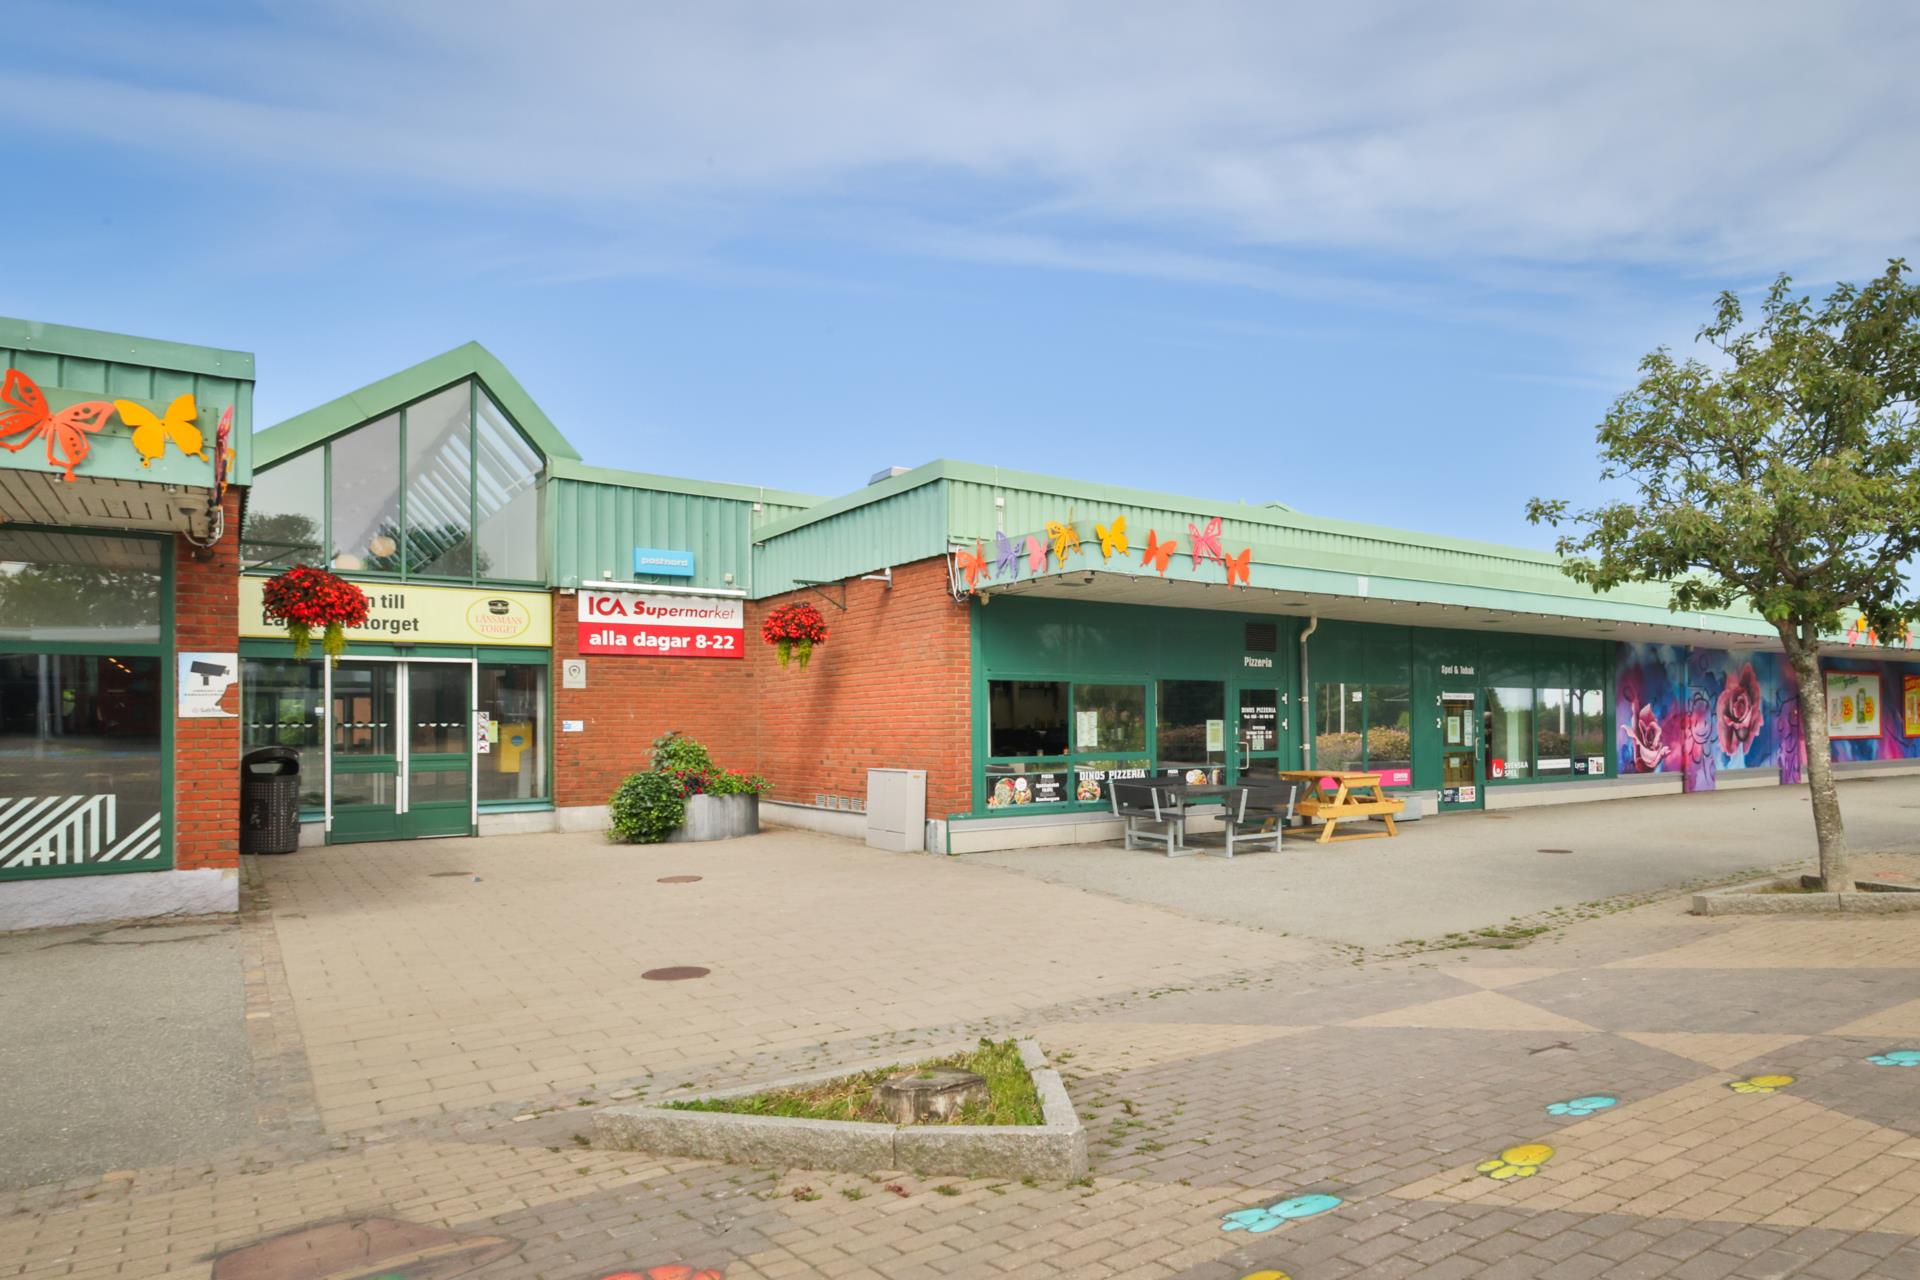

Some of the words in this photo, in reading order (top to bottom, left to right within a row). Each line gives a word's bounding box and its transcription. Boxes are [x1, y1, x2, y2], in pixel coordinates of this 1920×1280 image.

[640, 556, 689, 567] postnord
[380, 594, 405, 609] till
[588, 596, 628, 617] ICA
[633, 601, 735, 620] Supermarket
[588, 630, 628, 646] alla
[633, 632, 691, 651] dagar
[695, 634, 735, 650] 8-22
[1244, 656, 1273, 668] Pizzeria
[1441, 664, 1453, 675] Spel
[1460, 665, 1475, 675] Tobak
[1079, 770, 1105, 780] DINOS
[1109, 769, 1146, 779] PIZZERIA
